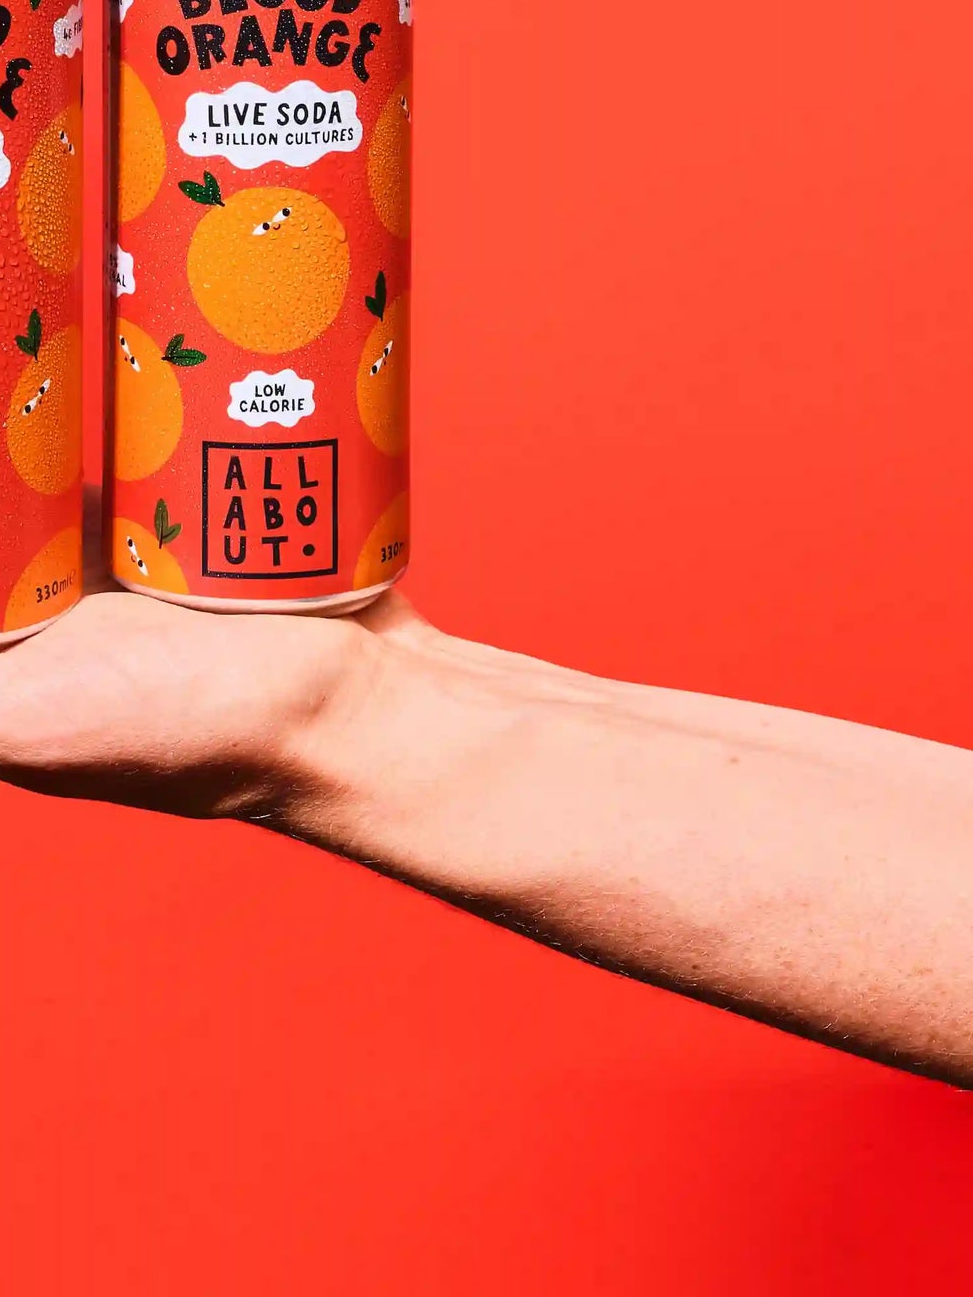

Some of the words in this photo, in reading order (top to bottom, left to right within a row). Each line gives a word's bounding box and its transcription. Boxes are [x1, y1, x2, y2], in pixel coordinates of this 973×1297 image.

[156, 9, 383, 83] ORANGE
[208, 102, 266, 128] LIVE
[277, 101, 342, 125] SODA
[215, 132, 278, 146] BILLION
[285, 127, 354, 145] CULTURES
[255, 384, 286, 398] LOW
[239, 398, 306, 413] CALORIE
[223, 455, 319, 490] ALL
[223, 495, 318, 531] ABO
